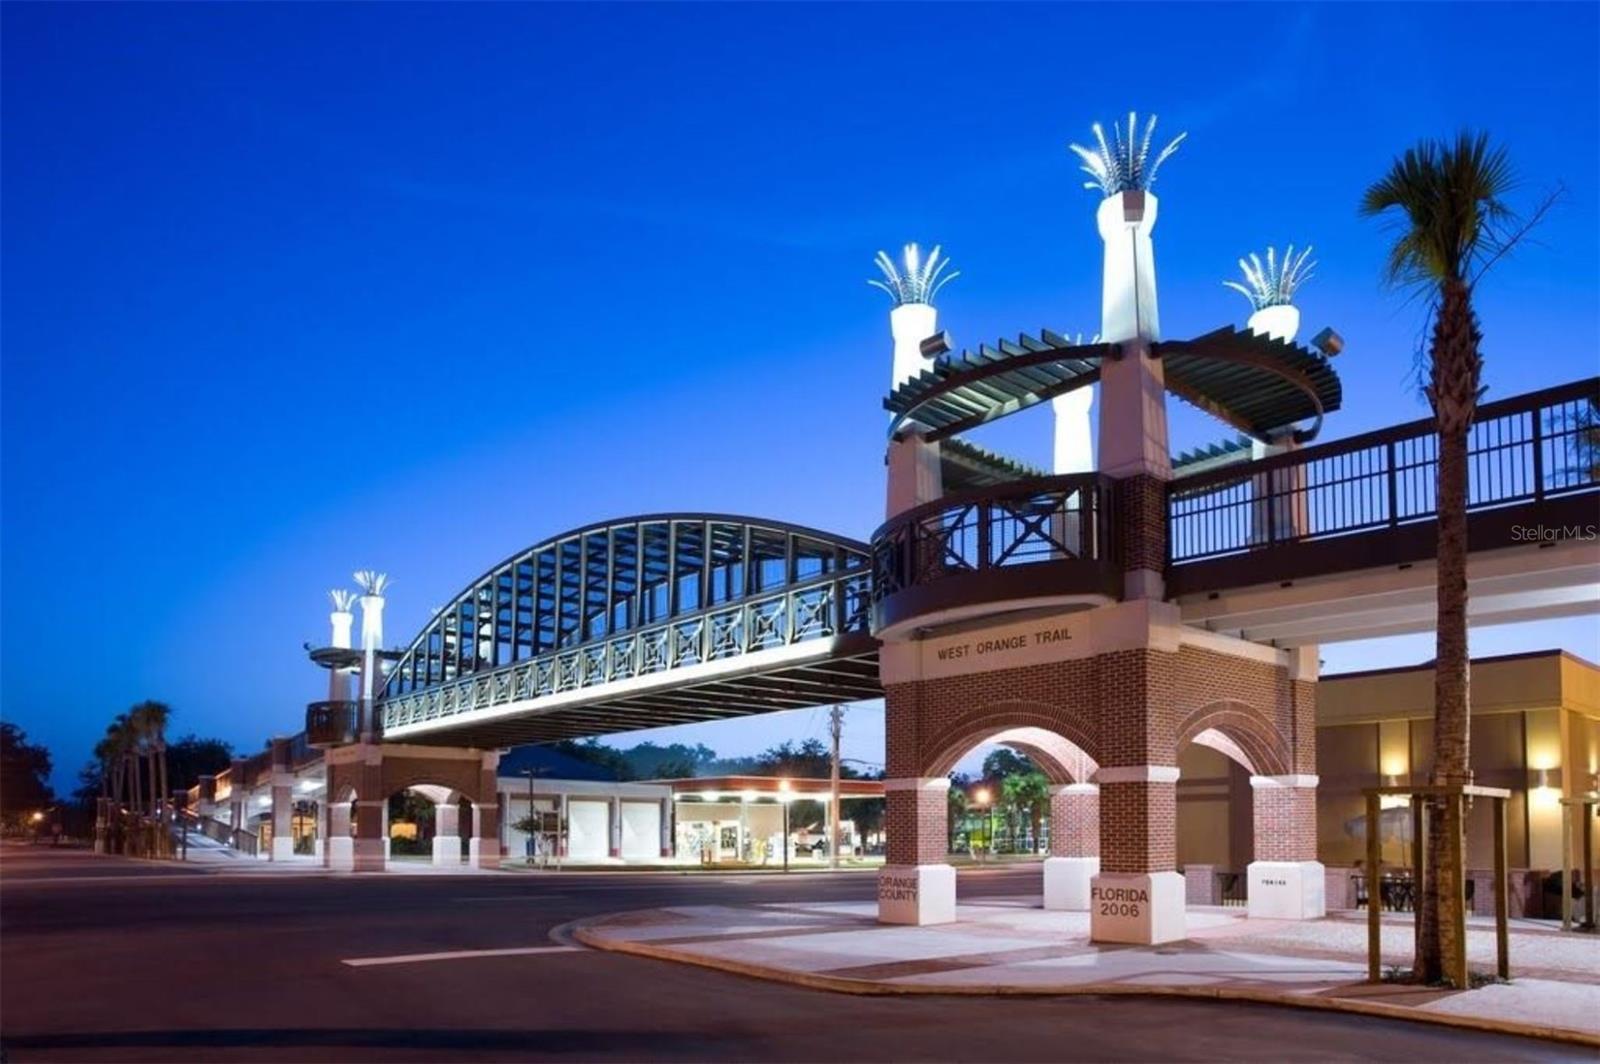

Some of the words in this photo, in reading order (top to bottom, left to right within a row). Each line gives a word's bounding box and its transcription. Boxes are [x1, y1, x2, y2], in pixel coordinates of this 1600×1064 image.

[937, 644, 969, 660] WEST
[976, 635, 1027, 655] ORANGE
[1035, 628, 1072, 644] TRAIL
[879, 875, 918, 889] ORANGE
[879, 888, 918, 901] COUNTY
[1091, 887, 1149, 903] FLORIDA
[1100, 902, 1139, 917] 2006
